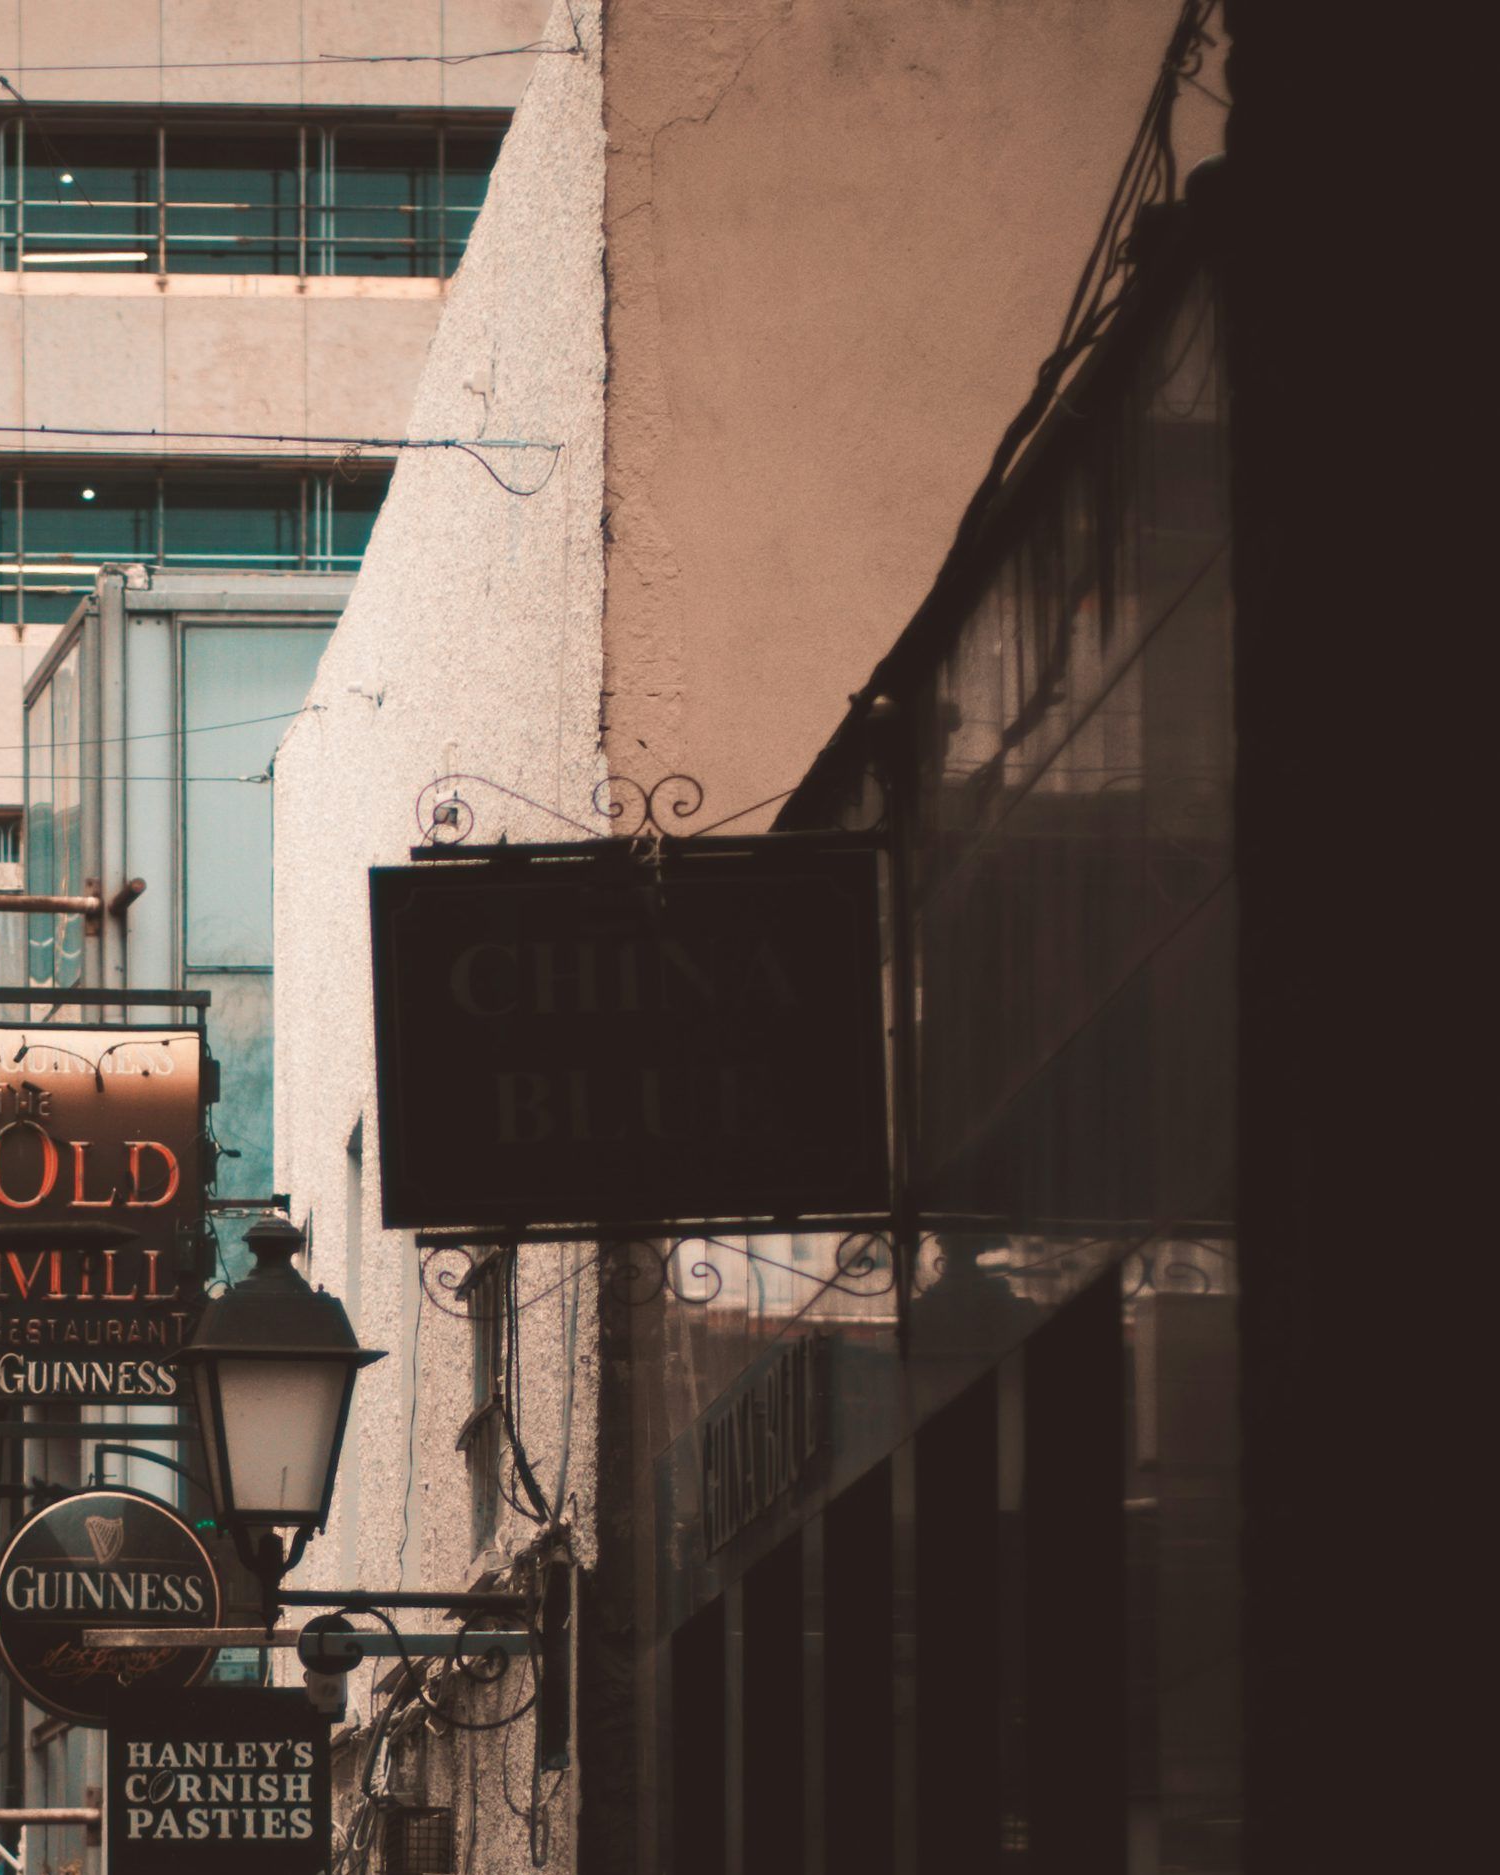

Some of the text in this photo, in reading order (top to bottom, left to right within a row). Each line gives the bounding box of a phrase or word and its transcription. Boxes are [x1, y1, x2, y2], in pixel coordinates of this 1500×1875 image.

[448, 936, 801, 1016] CHINA
[6, 1565, 204, 1613] GUINNESS
[127, 1739, 314, 1768] HANLEY'S
[125, 1769, 312, 1803] CORNISH
[127, 1807, 314, 1840] PASTIES
